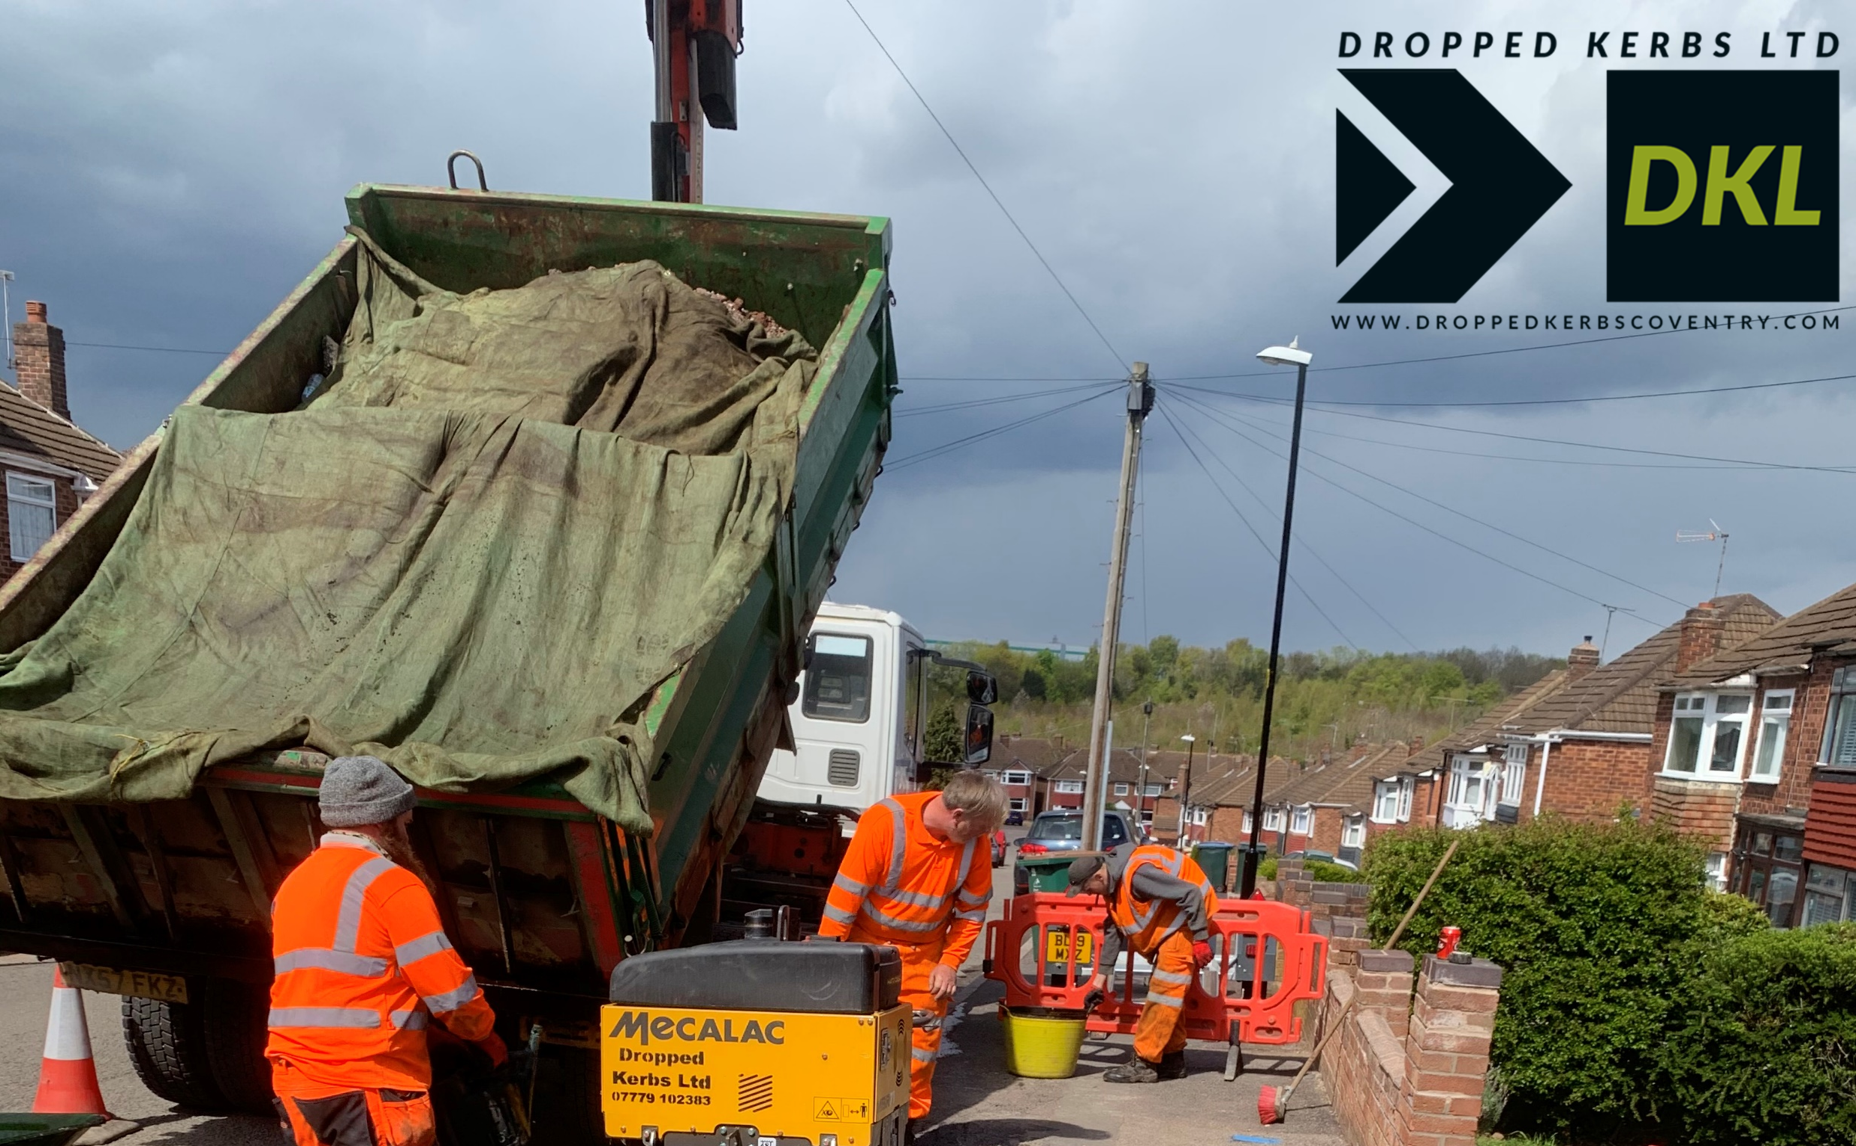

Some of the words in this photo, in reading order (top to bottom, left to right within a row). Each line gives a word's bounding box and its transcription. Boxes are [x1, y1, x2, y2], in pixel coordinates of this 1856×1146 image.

[1055, 934, 1085, 947] BD9
[131, 973, 178, 998] FKZ
[619, 1047, 704, 1067] Dropped
[612, 1071, 672, 1088] Kerbs
[678, 1073, 711, 1090] Ltd
[612, 1091, 655, 1104] 07779
[659, 1093, 711, 1106] 102383
